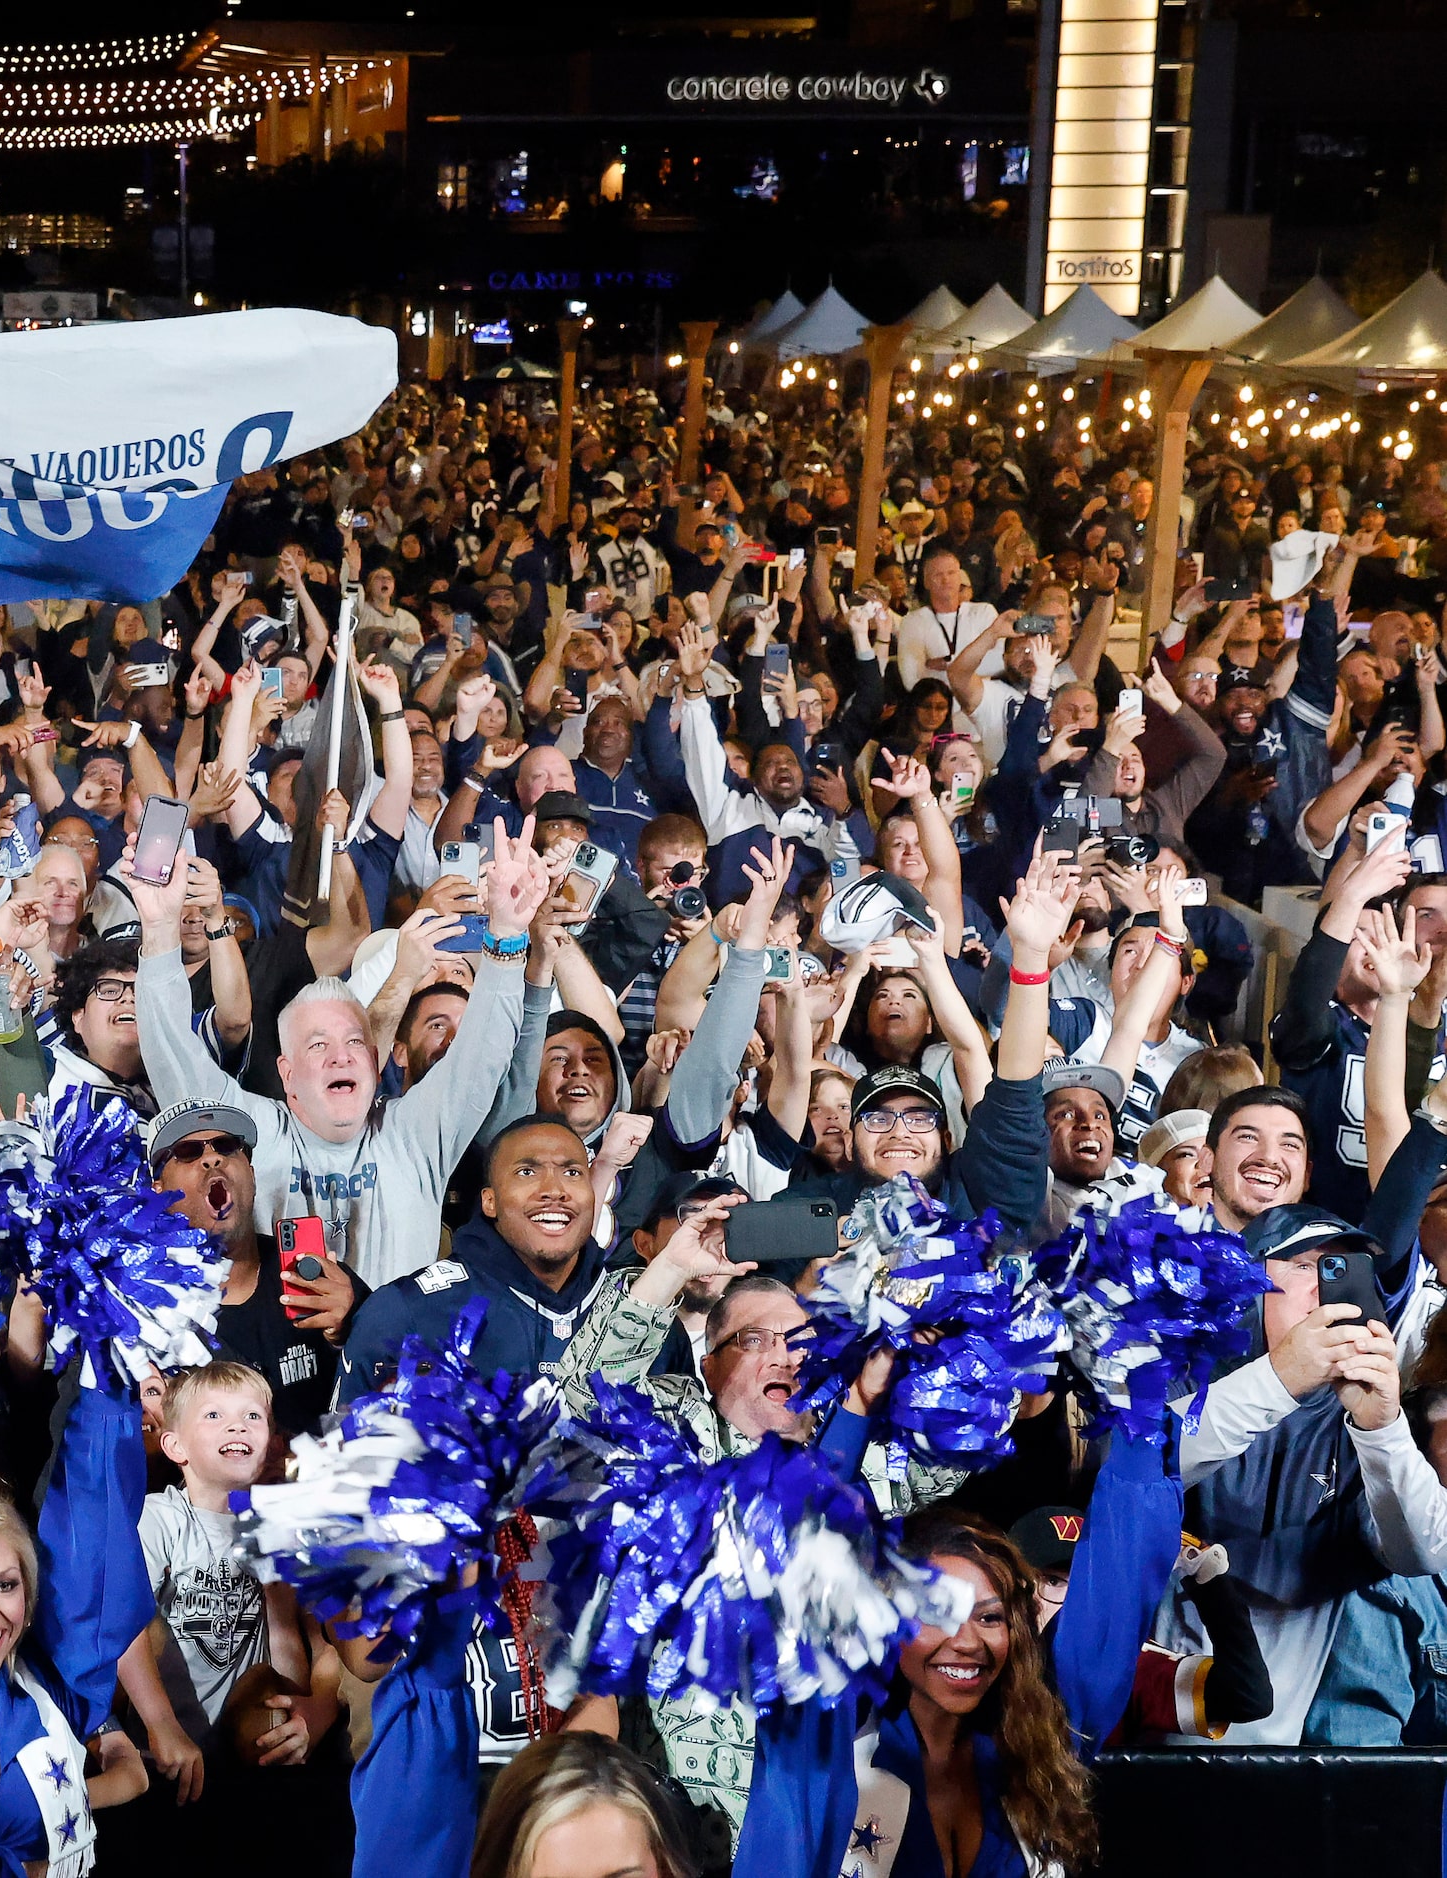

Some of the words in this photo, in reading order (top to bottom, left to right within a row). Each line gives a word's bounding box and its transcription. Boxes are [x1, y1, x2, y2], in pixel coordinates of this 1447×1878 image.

[667, 71, 790, 100] concrete
[797, 71, 906, 106] cowboy
[30, 428, 206, 488] VAQUEROS
[286, 1343, 307, 1360] 2021
[279, 1353, 318, 1387] DRAFT
